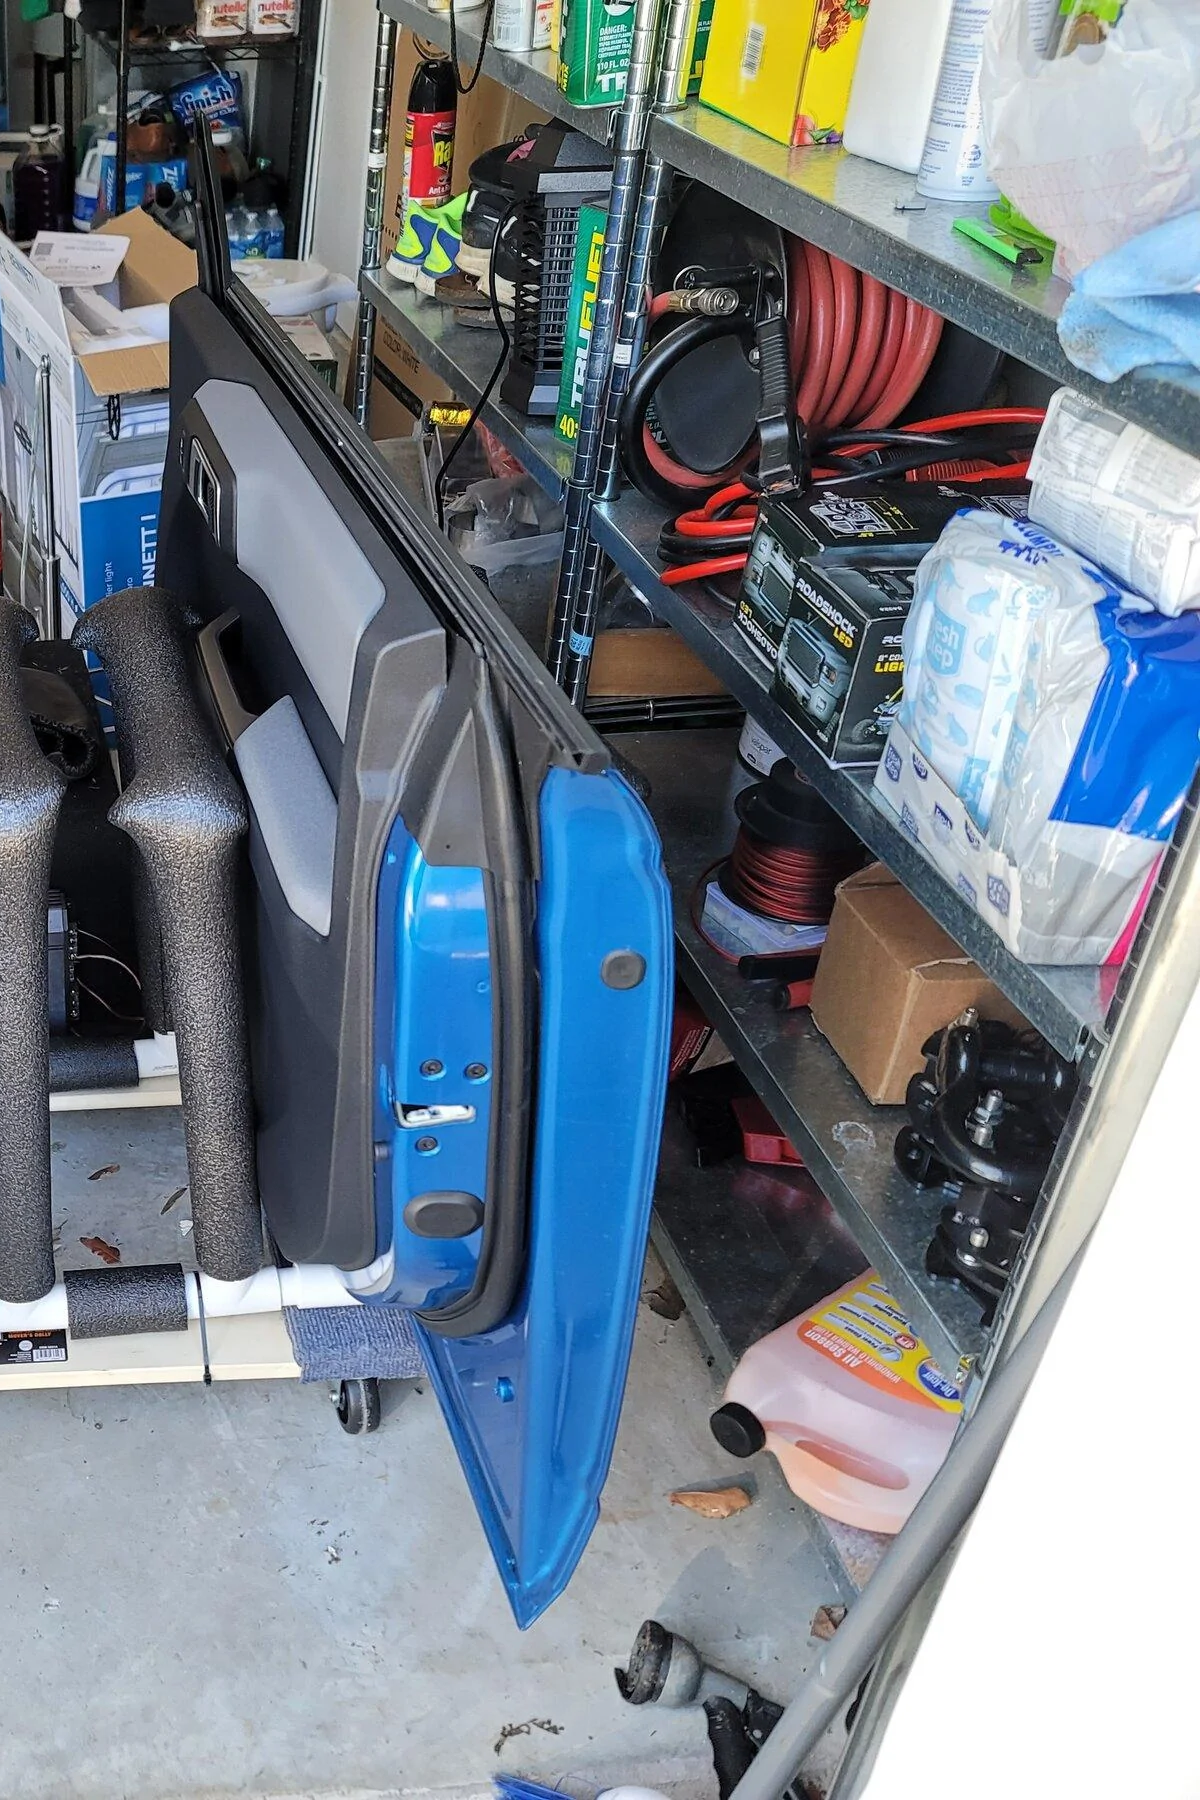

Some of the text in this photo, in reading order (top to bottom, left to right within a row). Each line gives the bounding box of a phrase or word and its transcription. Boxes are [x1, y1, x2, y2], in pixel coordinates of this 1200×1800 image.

[180, 84, 234, 115] finish
[141, 526, 157, 588] NNETT
[796, 577, 857, 639] ROADSHOCK
[737, 610, 779, 660] OADSHOCK
[832, 626, 854, 649] LED
[804, 1329, 865, 1368] All Season
